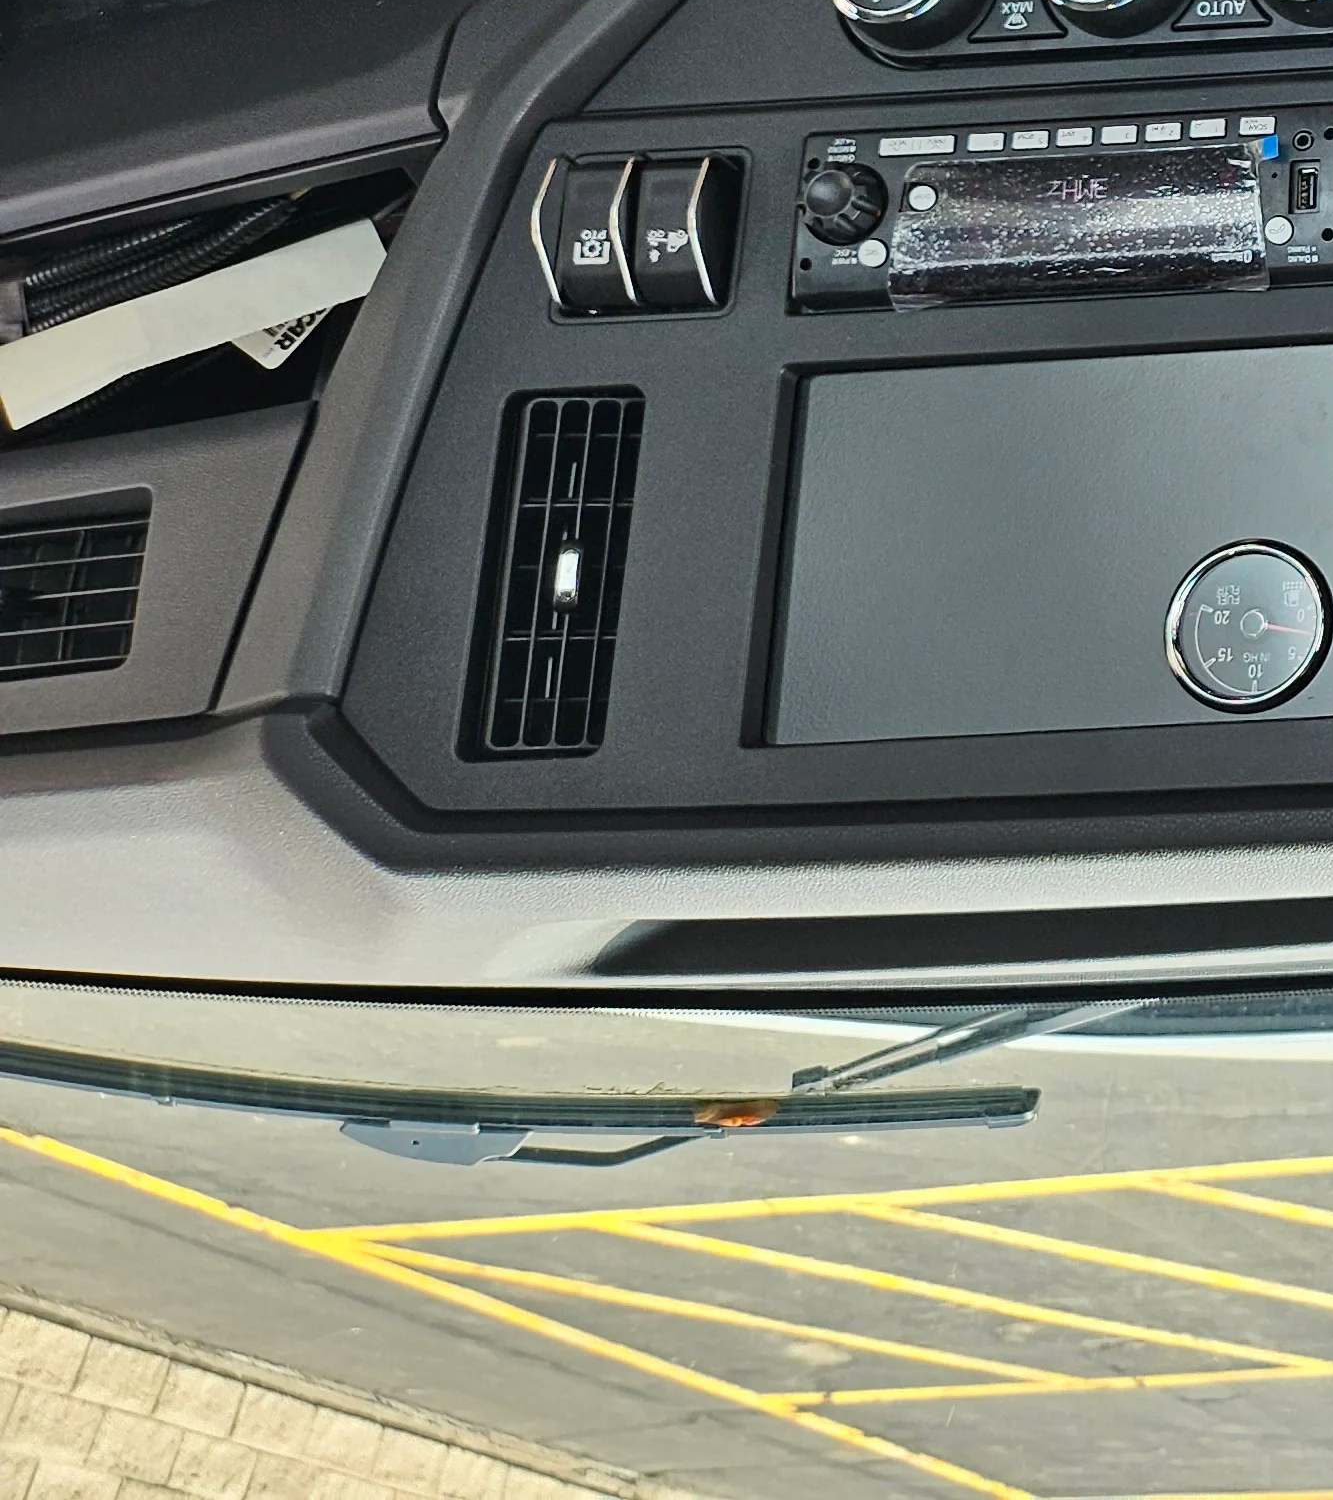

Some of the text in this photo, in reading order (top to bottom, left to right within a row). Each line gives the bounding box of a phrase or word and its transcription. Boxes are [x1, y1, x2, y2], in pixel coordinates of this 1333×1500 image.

[580, 229, 608, 241] PTO
[1216, 584, 1240, 594] FLTR
[1216, 595, 1240, 604] FUEL
[1214, 610, 1230, 624] 20
[1296, 608, 1304, 622] 0
[1217, 648, 1233, 662] 15
[1288, 646, 1296, 660] 5
[1248, 664, 1264, 678] 10
